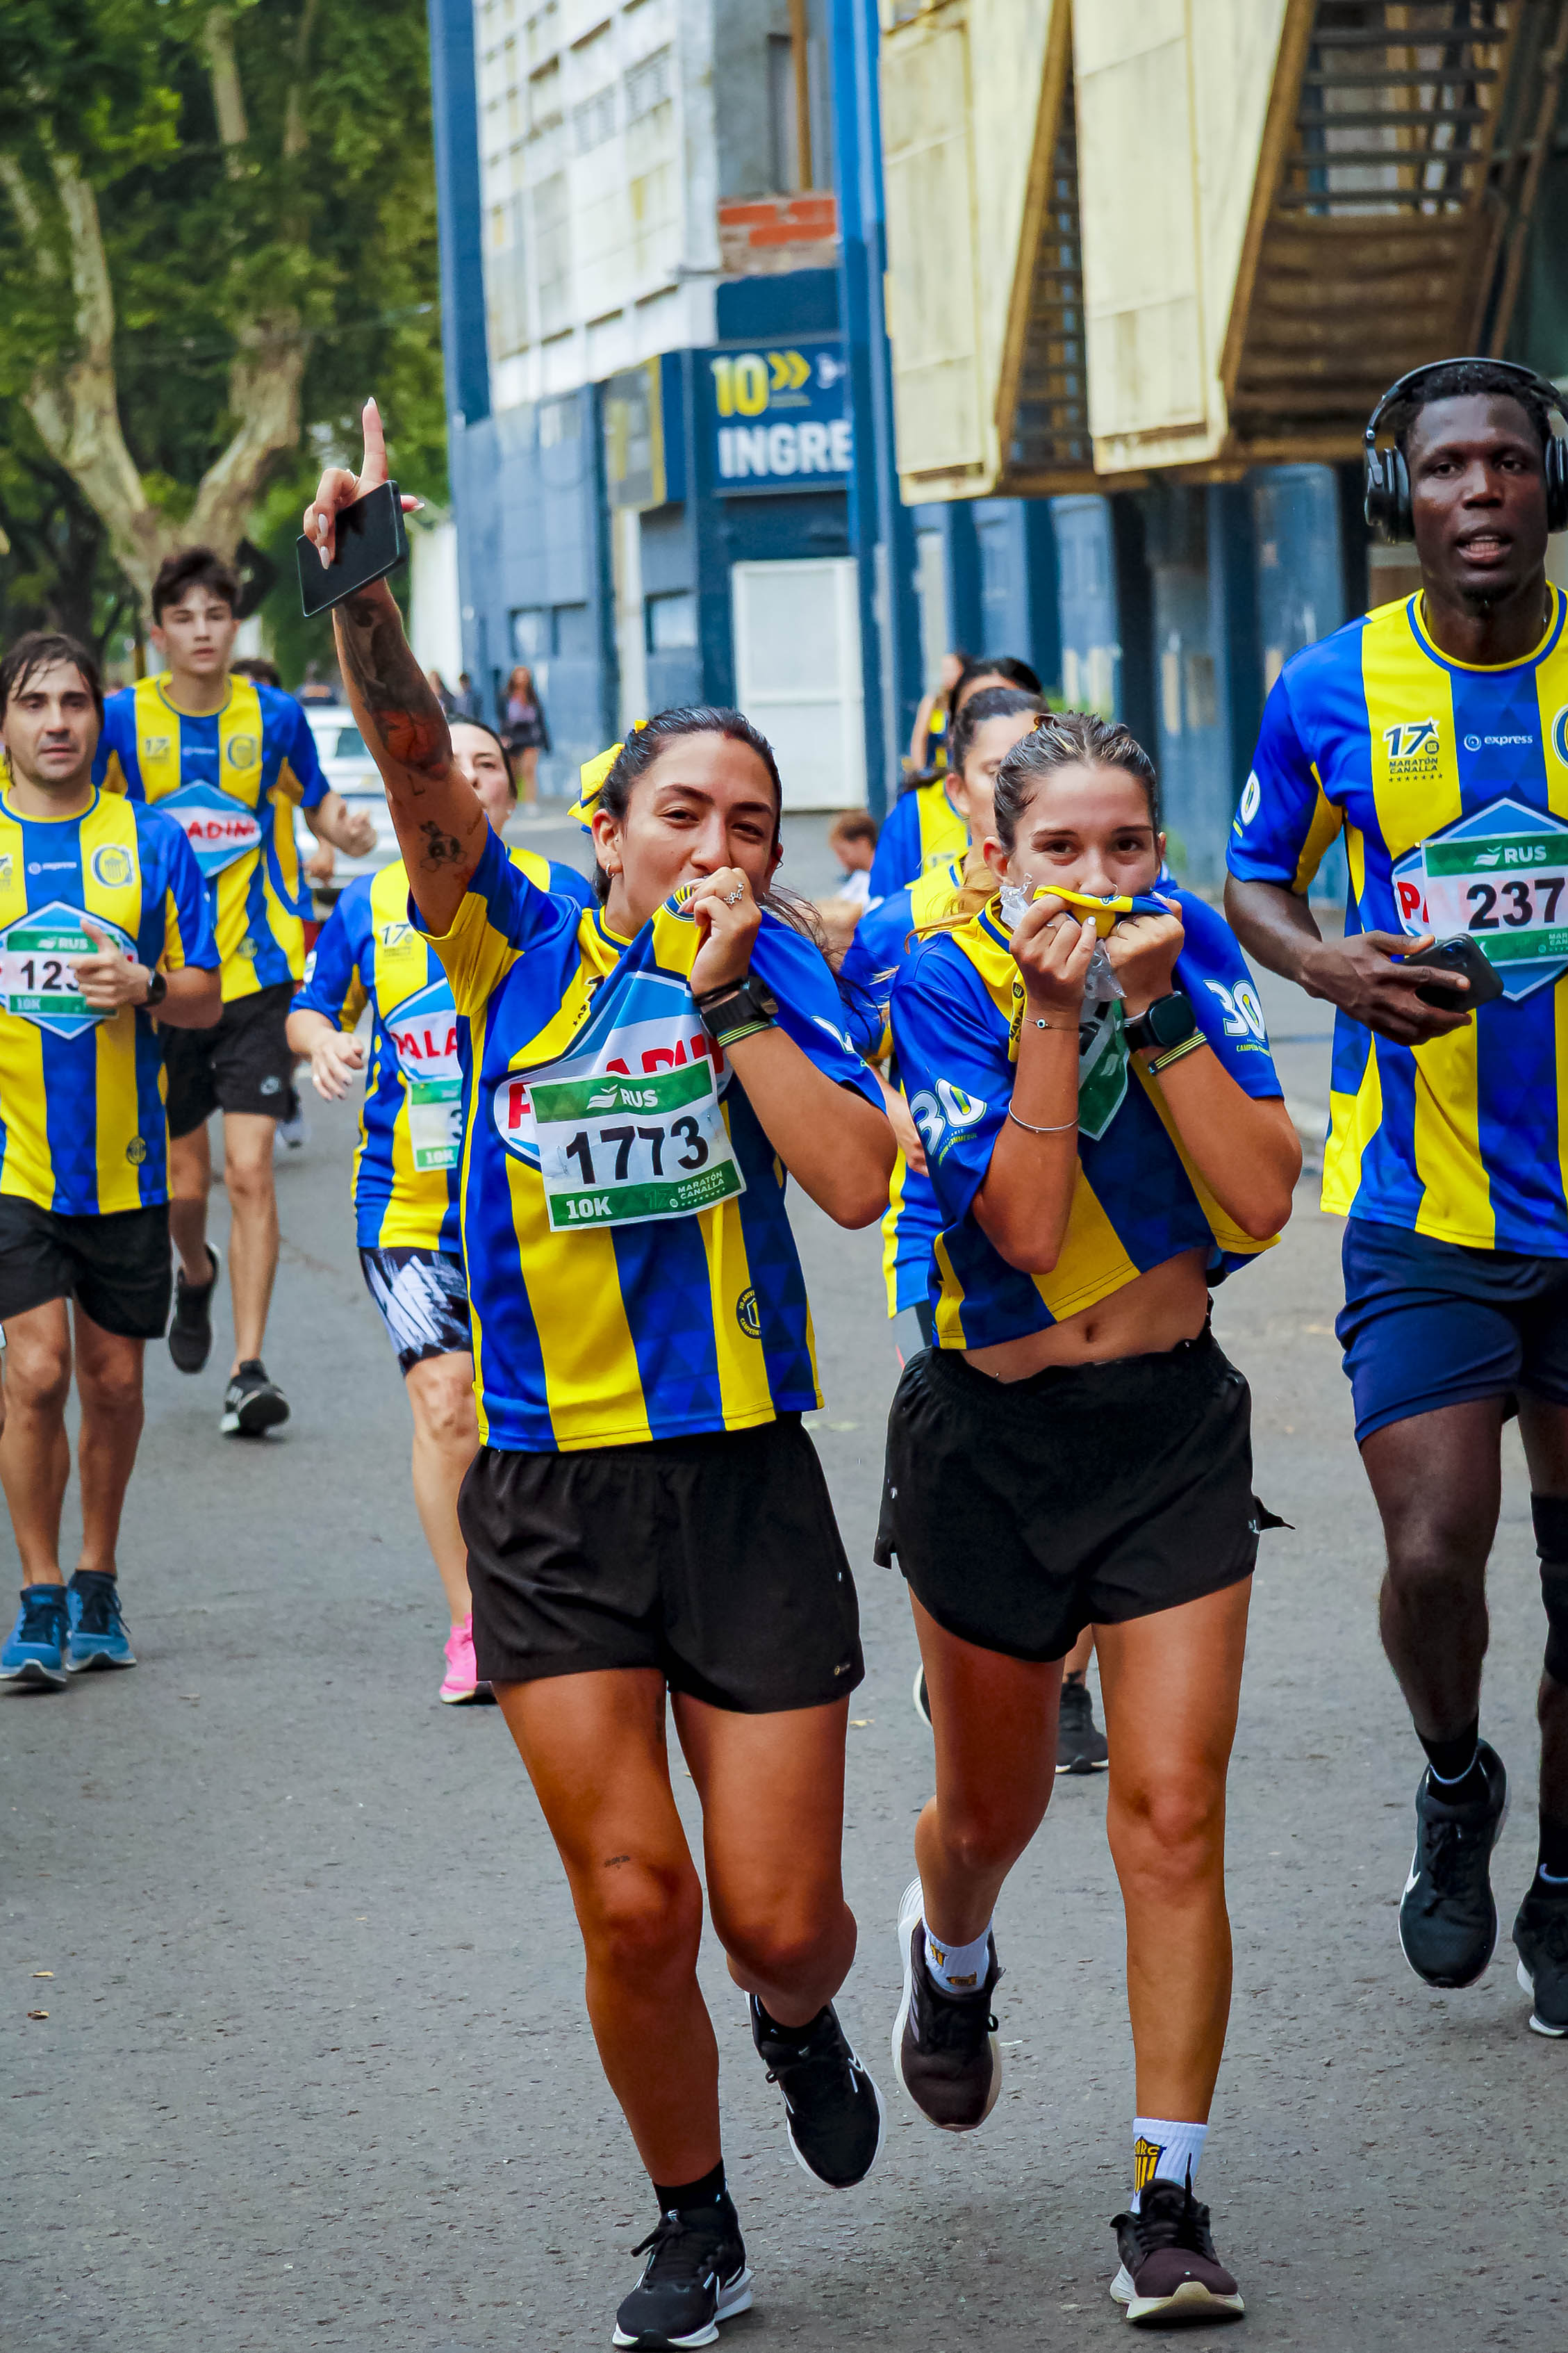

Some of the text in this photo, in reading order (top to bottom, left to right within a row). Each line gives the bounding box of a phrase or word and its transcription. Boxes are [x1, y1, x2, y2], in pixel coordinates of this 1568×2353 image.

[710, 353, 769, 417] 10
[718, 419, 853, 478] INGRE
[1383, 716, 1439, 759] 17
[1484, 735, 1533, 746] express
[1389, 765, 1437, 774] CANALLA
[1504, 845, 1547, 863] RUS
[1466, 878, 1565, 930] 237
[58, 937, 88, 951] RUS
[1203, 980, 1266, 1042] 30
[620, 1088, 658, 1108] RUS
[910, 1078, 987, 1156] 30
[566, 1115, 709, 1185] 1773
[677, 1170, 723, 1194] MARATÓN
[680, 1178, 725, 1200] CANALLA
[566, 1196, 612, 1220] 10K
